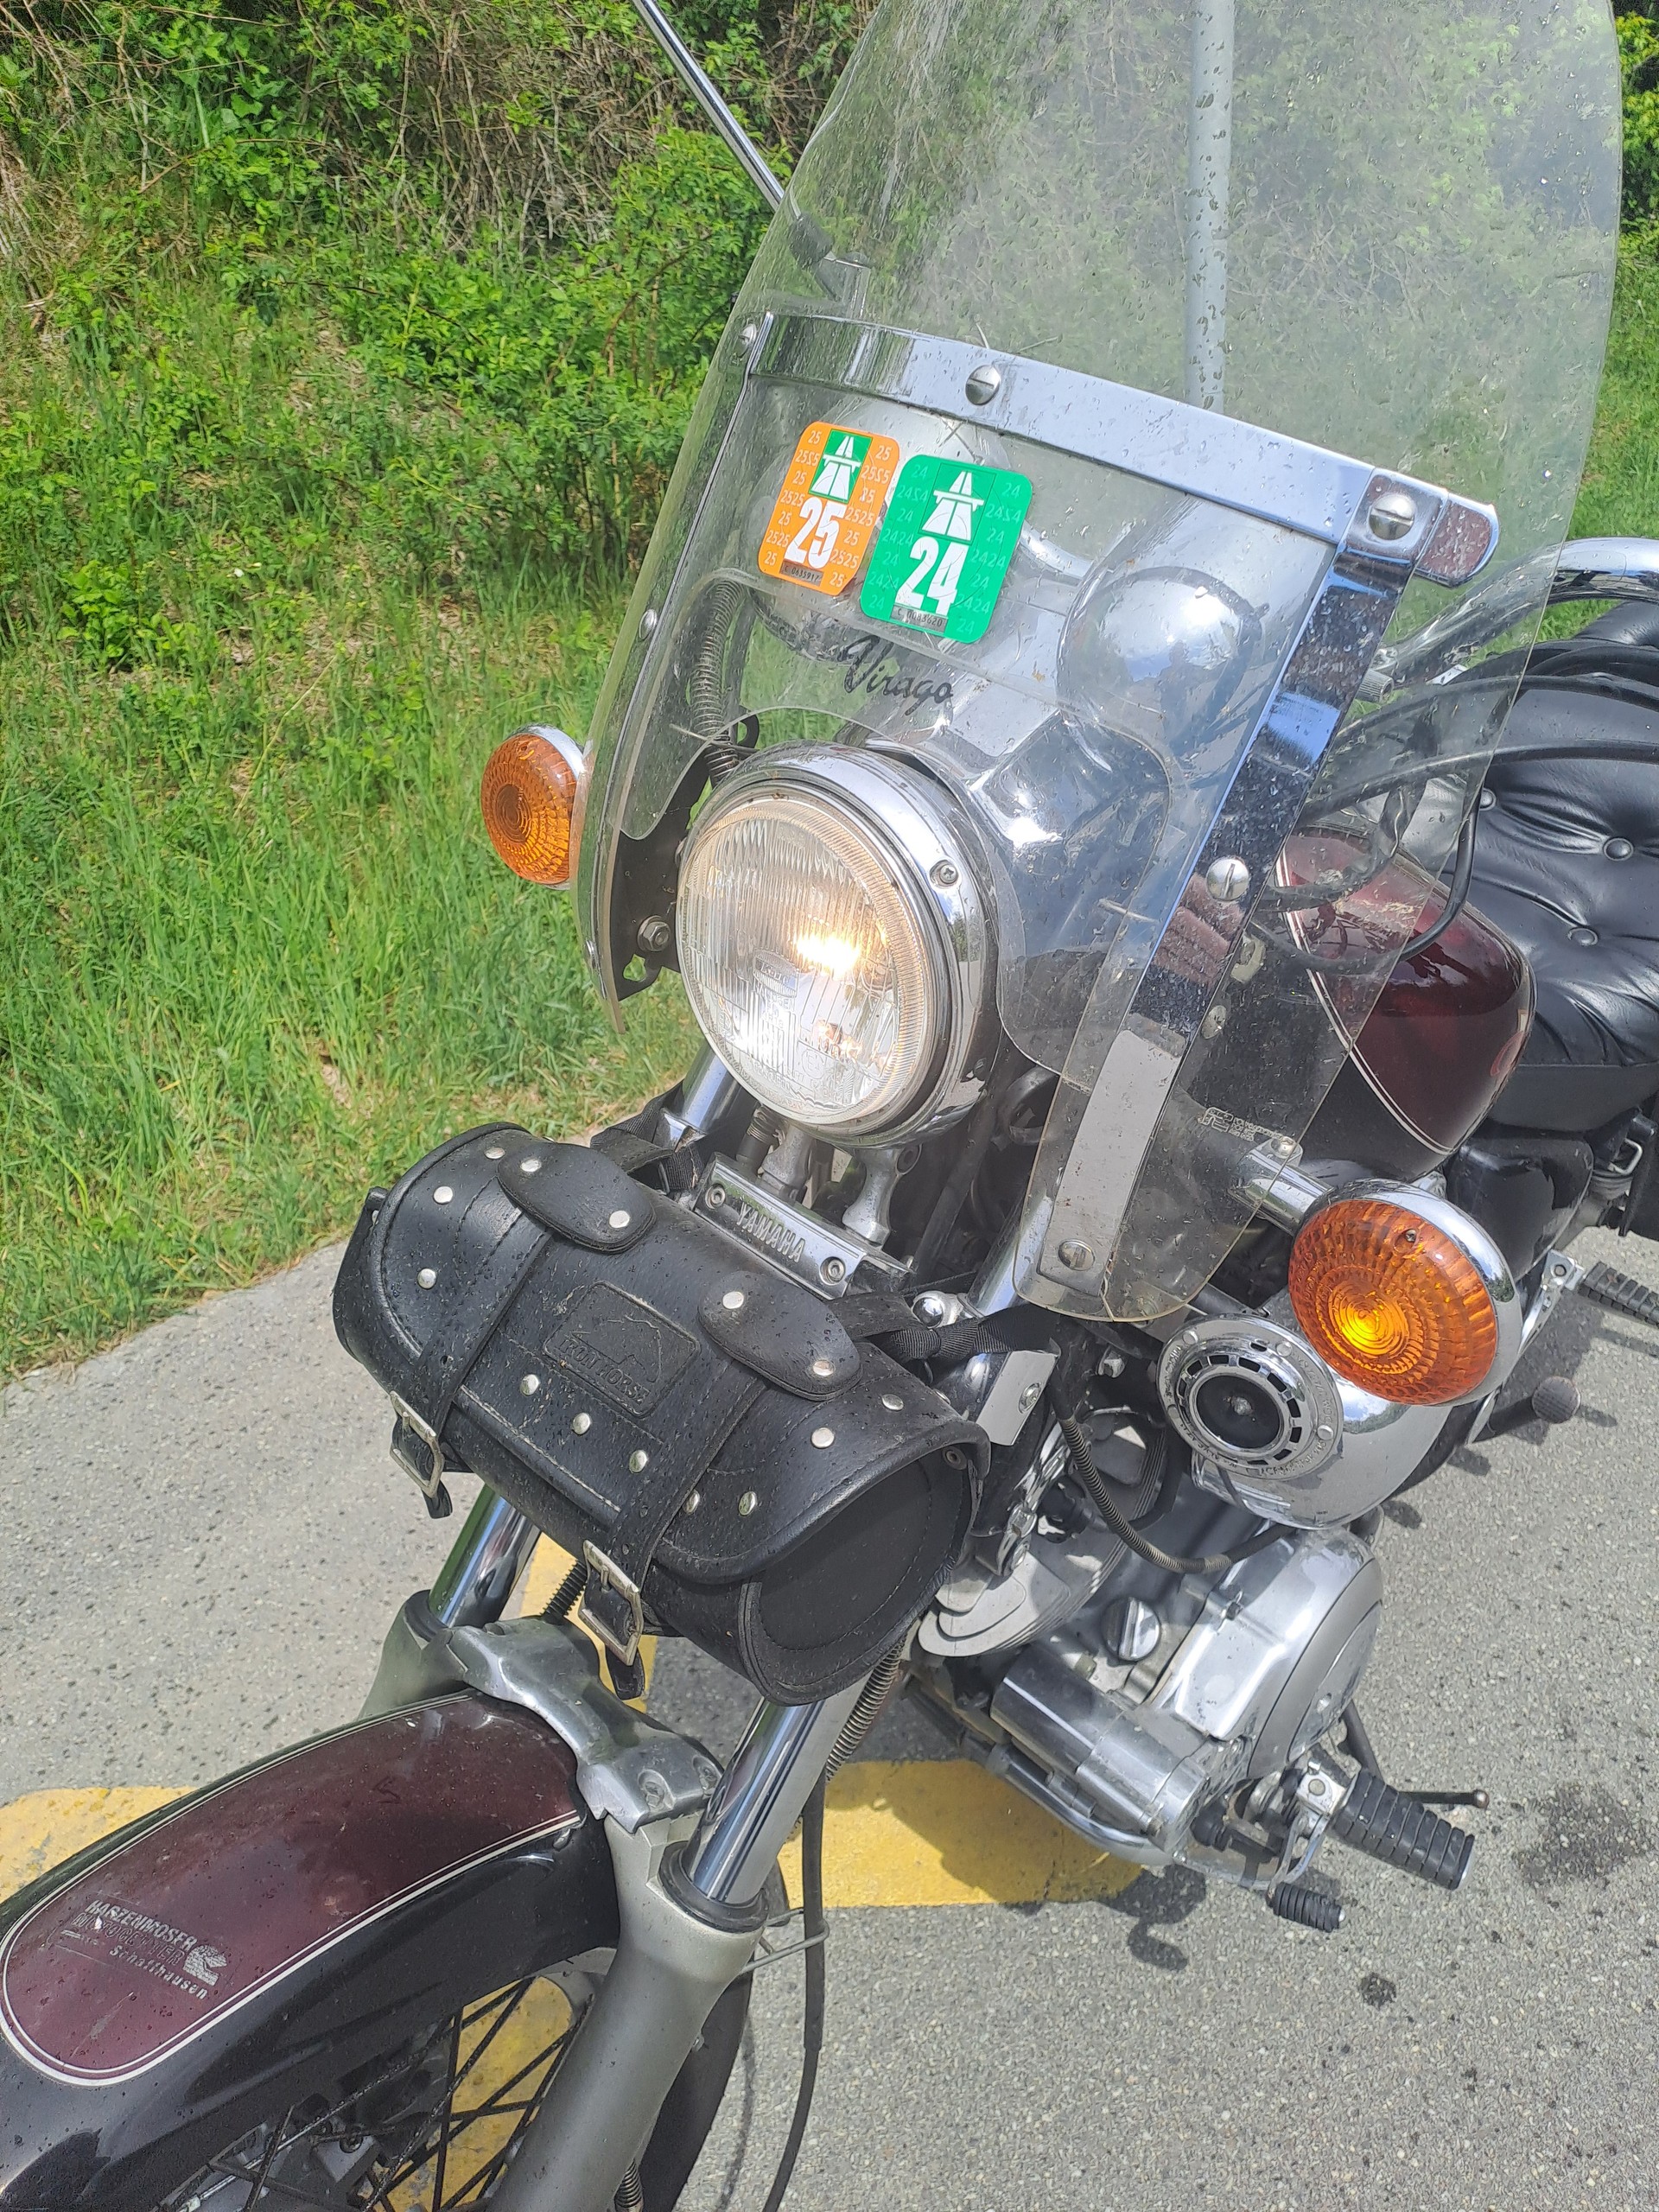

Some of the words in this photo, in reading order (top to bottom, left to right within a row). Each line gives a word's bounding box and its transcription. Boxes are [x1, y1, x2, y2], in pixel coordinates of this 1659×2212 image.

[808, 430, 821, 444] 25
[875, 445, 893, 461] 25
[792, 471, 807, 485] 25
[778, 512, 792, 525] 25
[785, 496, 848, 569] 25
[843, 531, 860, 546] 25
[764, 551, 778, 565] 25
[830, 572, 846, 587] 25
[894, 536, 969, 617] 24
[836, 634, 953, 716] Virago
[736, 1202, 805, 1263] YAMAHA
[595, 1364, 650, 1405] HORSE
